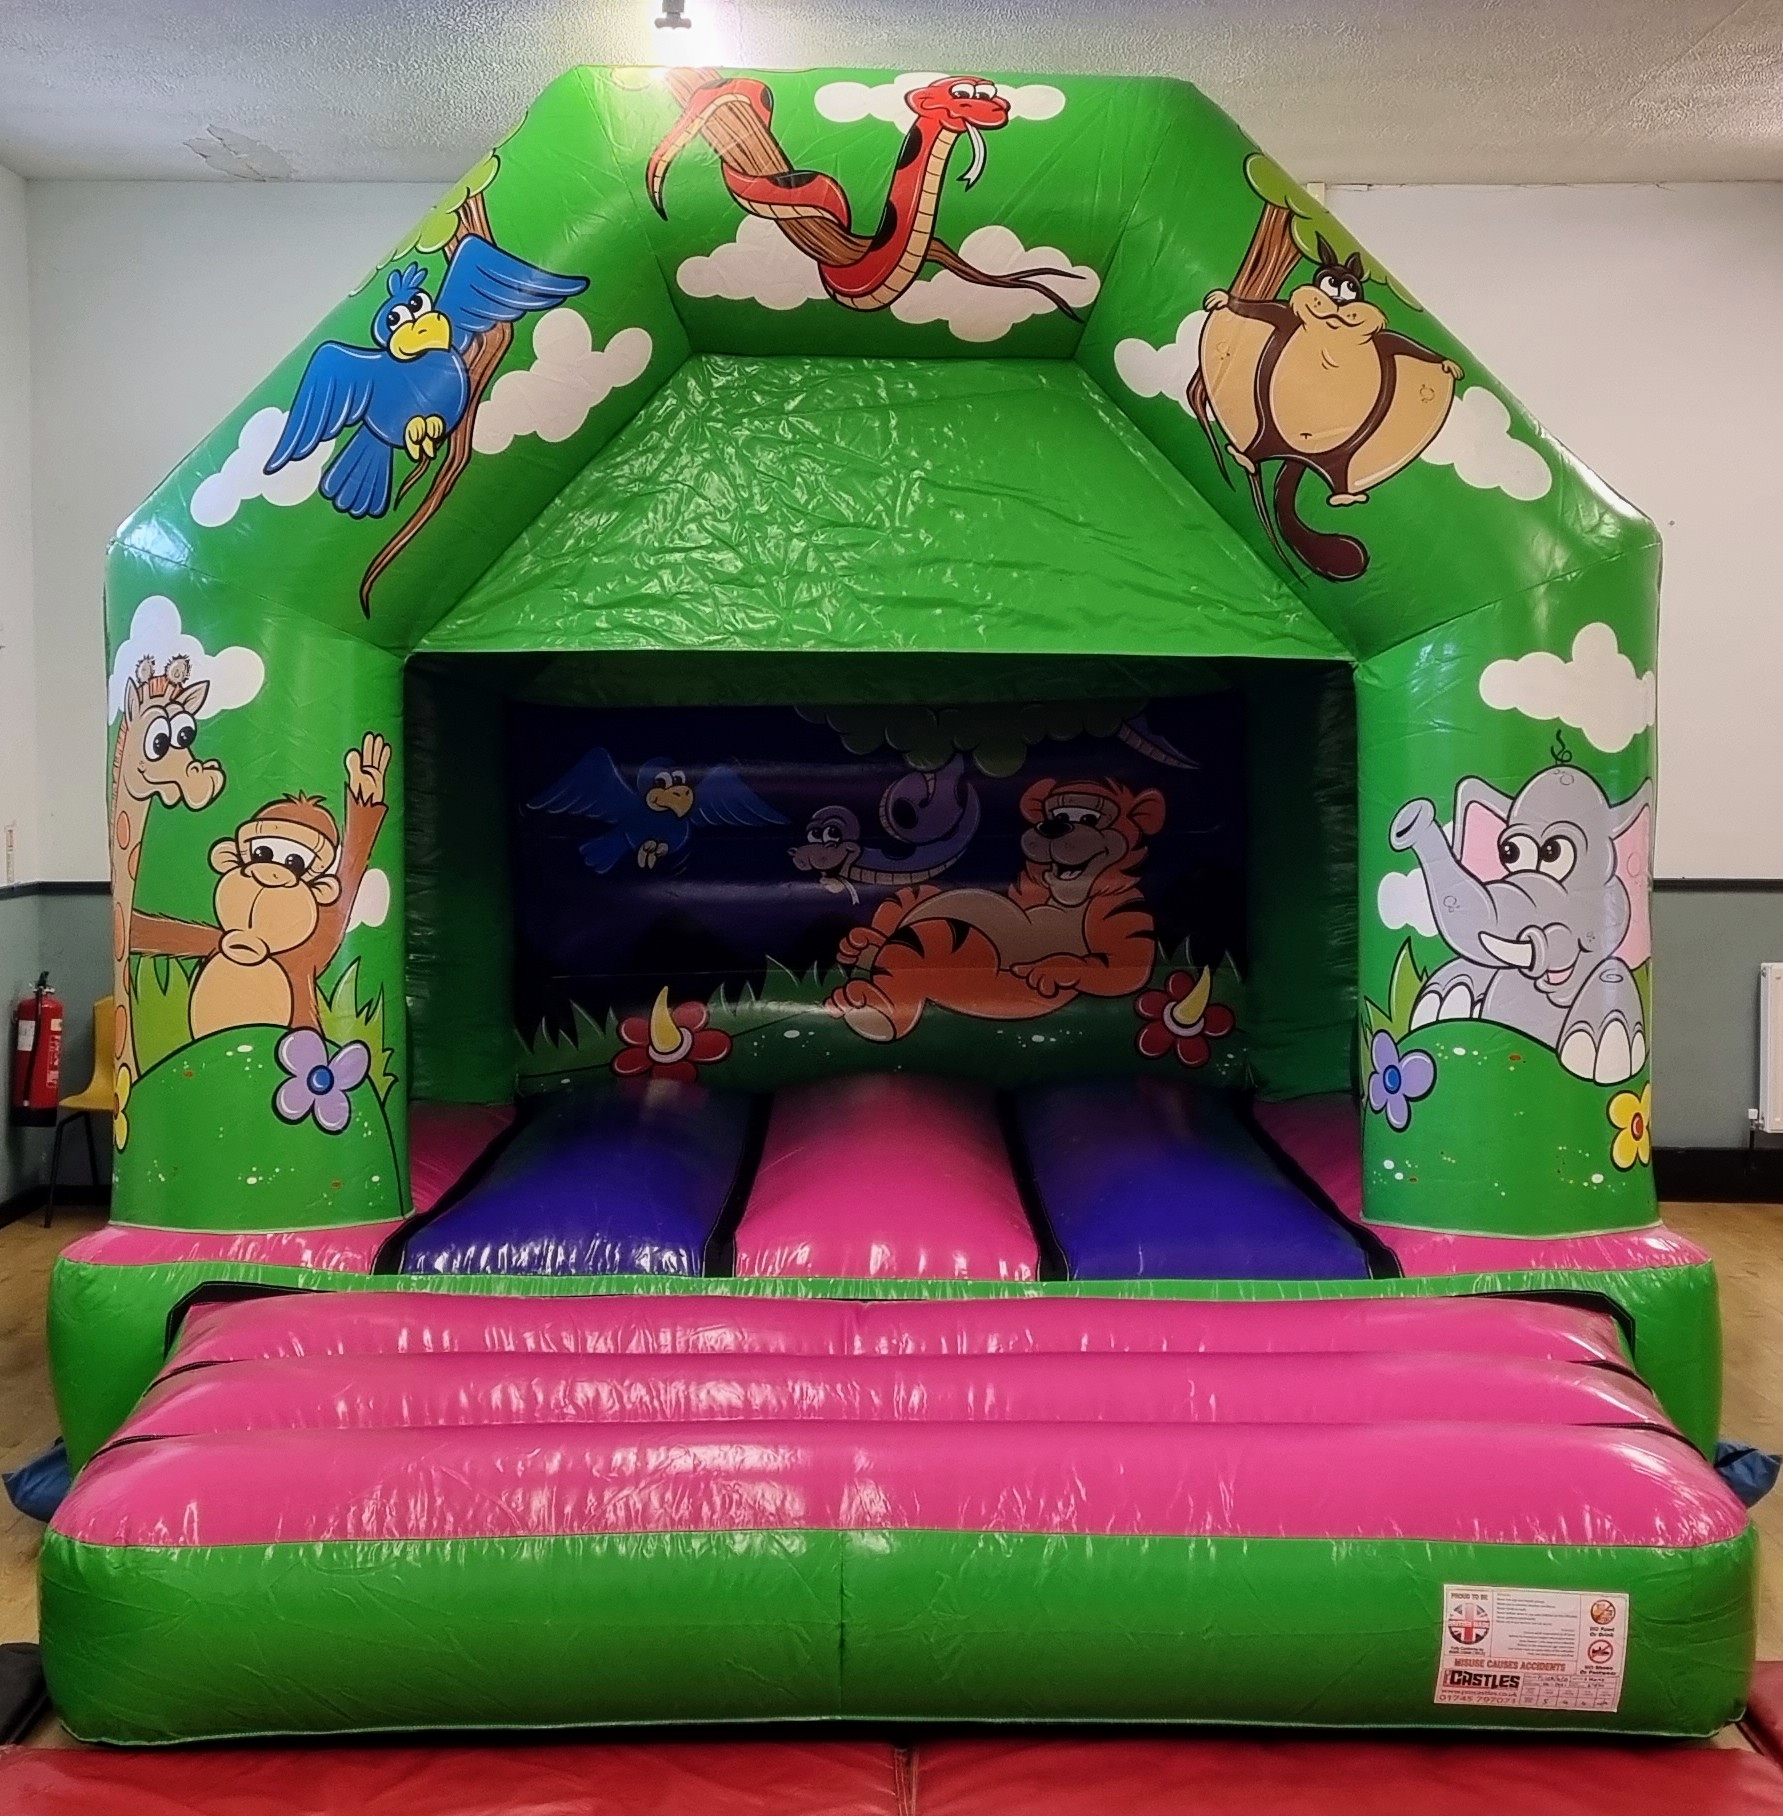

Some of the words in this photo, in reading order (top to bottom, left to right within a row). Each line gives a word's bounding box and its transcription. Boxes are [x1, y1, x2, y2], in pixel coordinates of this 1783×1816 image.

[1454, 1657, 1484, 1669] MISUSE
[1487, 1659, 1519, 1670] CAUSES
[1520, 1660, 1567, 1672] ACCIDENTS
[1449, 1669, 1521, 1690] CASTLES
[1439, 1694, 1474, 1703] 01745
